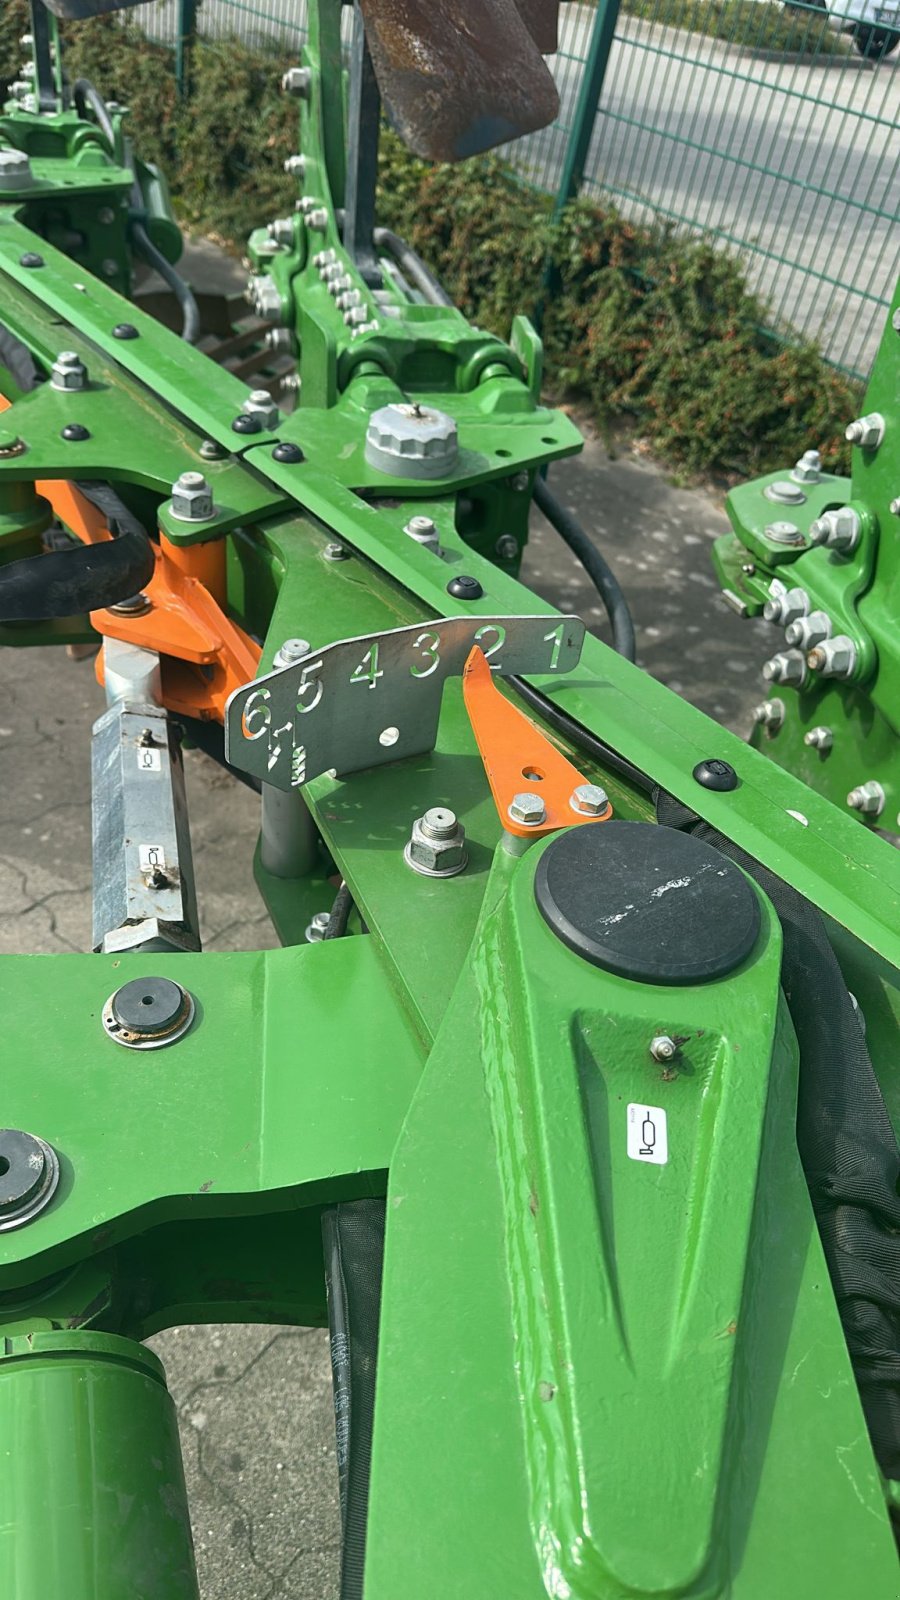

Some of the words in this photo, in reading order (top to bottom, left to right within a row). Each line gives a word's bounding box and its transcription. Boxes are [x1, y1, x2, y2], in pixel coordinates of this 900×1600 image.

[241, 688, 272, 741] 6
[296, 659, 324, 714] 5
[349, 642, 384, 689] 4
[409, 631, 441, 679] 3
[473, 624, 507, 670] 2
[543, 623, 566, 669] 1
